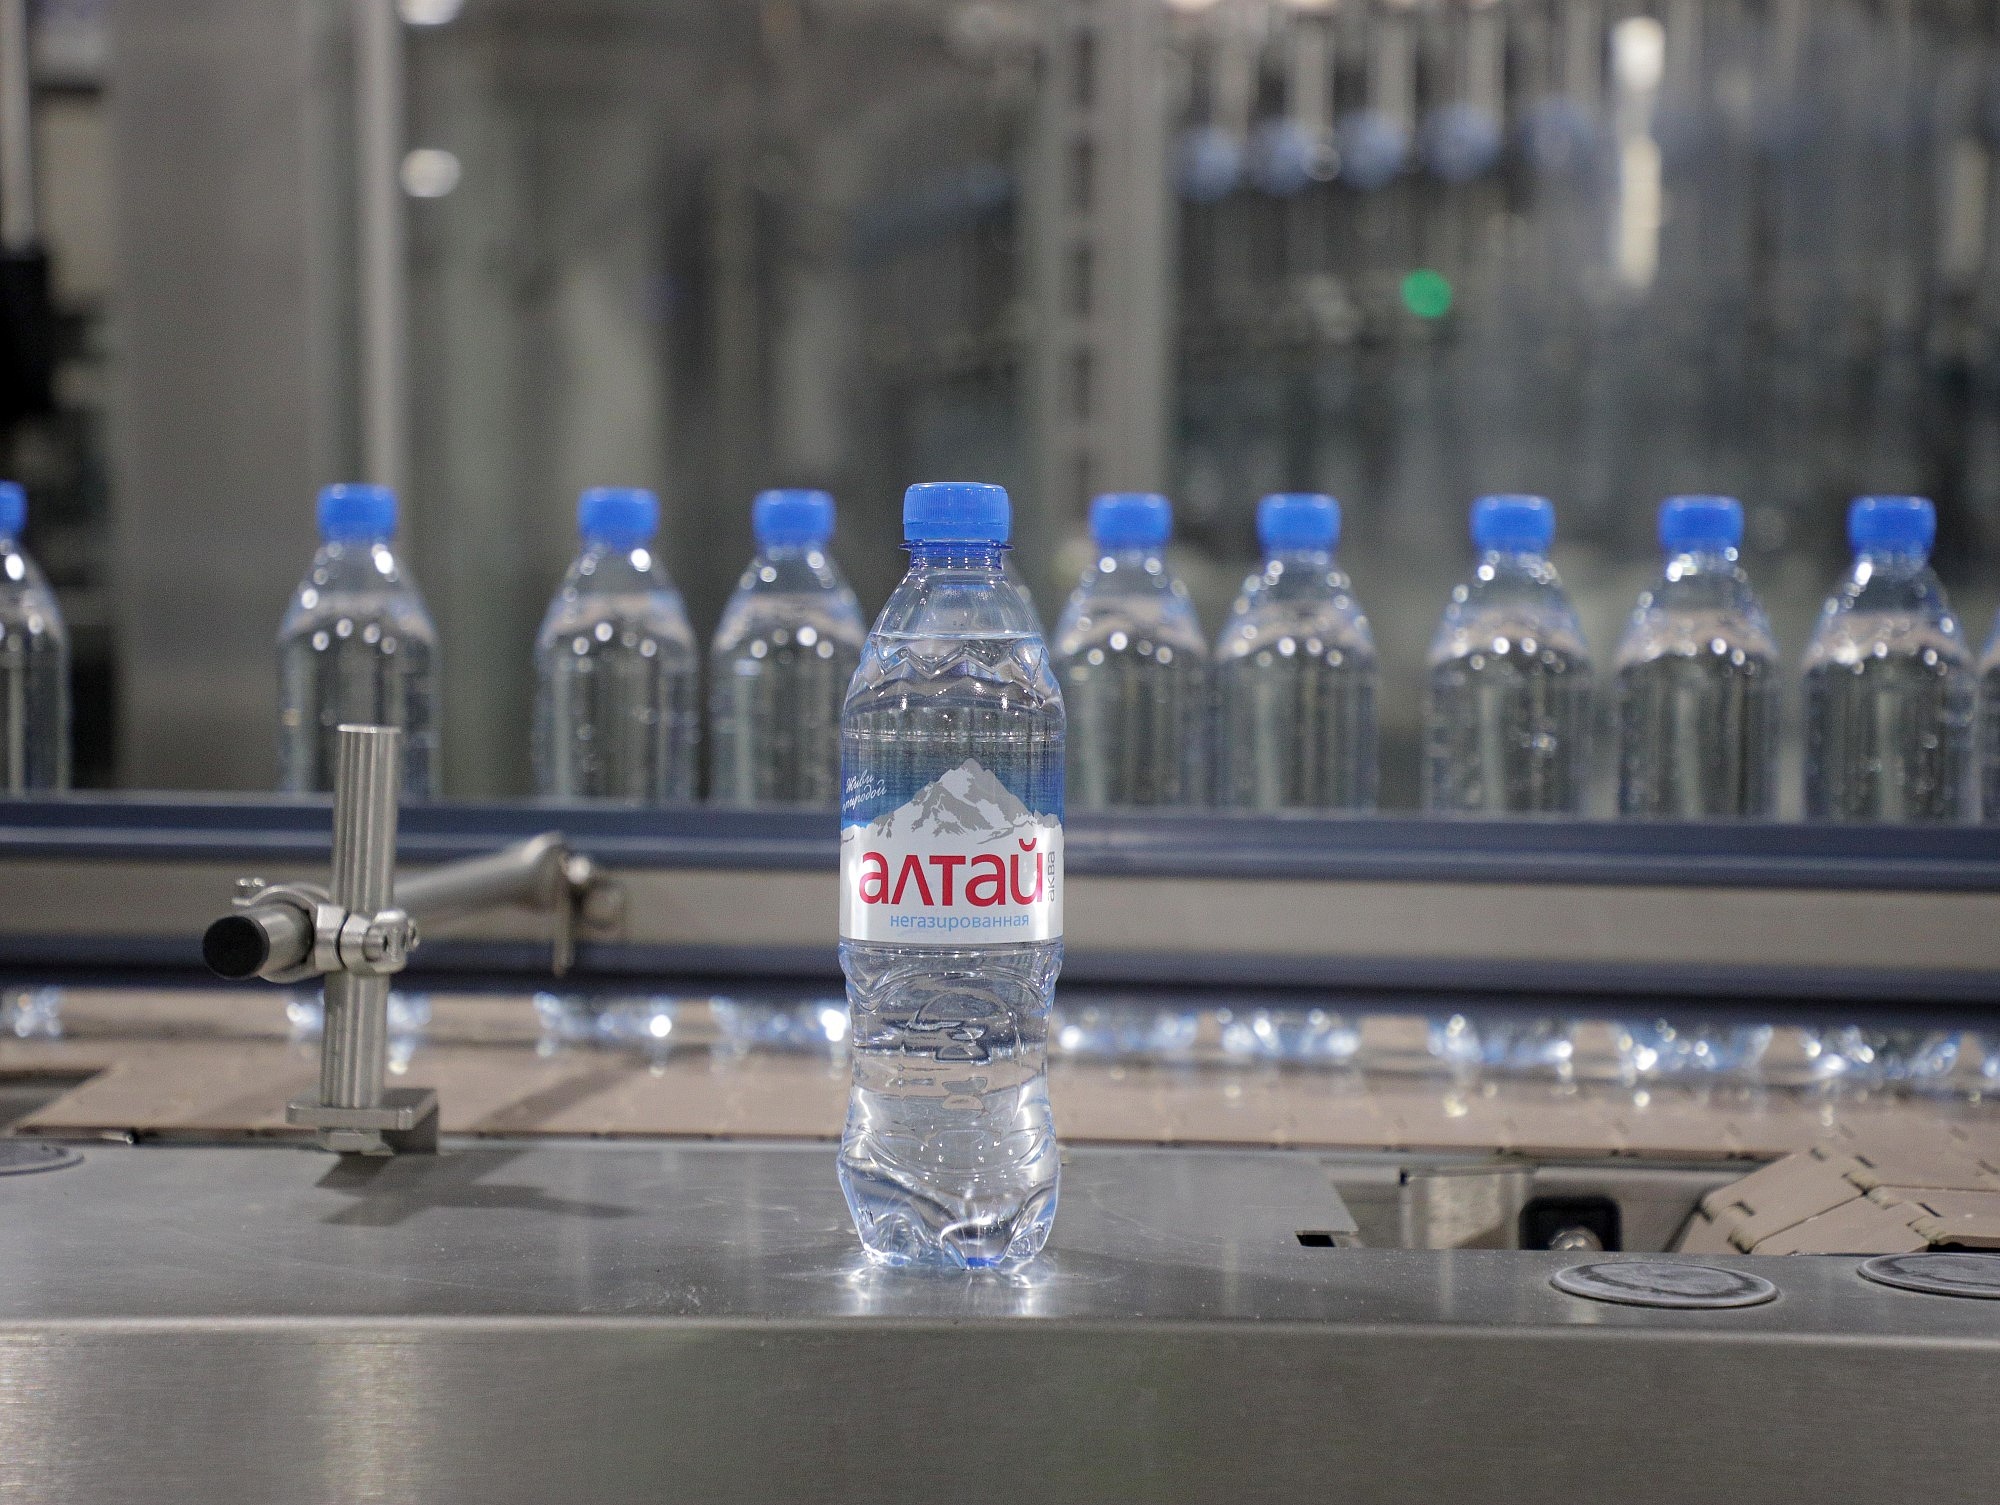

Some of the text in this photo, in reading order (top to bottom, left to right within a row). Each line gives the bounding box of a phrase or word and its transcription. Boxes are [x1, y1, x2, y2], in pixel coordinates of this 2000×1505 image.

[859, 838, 1043, 907] алтай
[1047, 851, 1056, 902] аква
[890, 914, 1029, 932] негазированная
